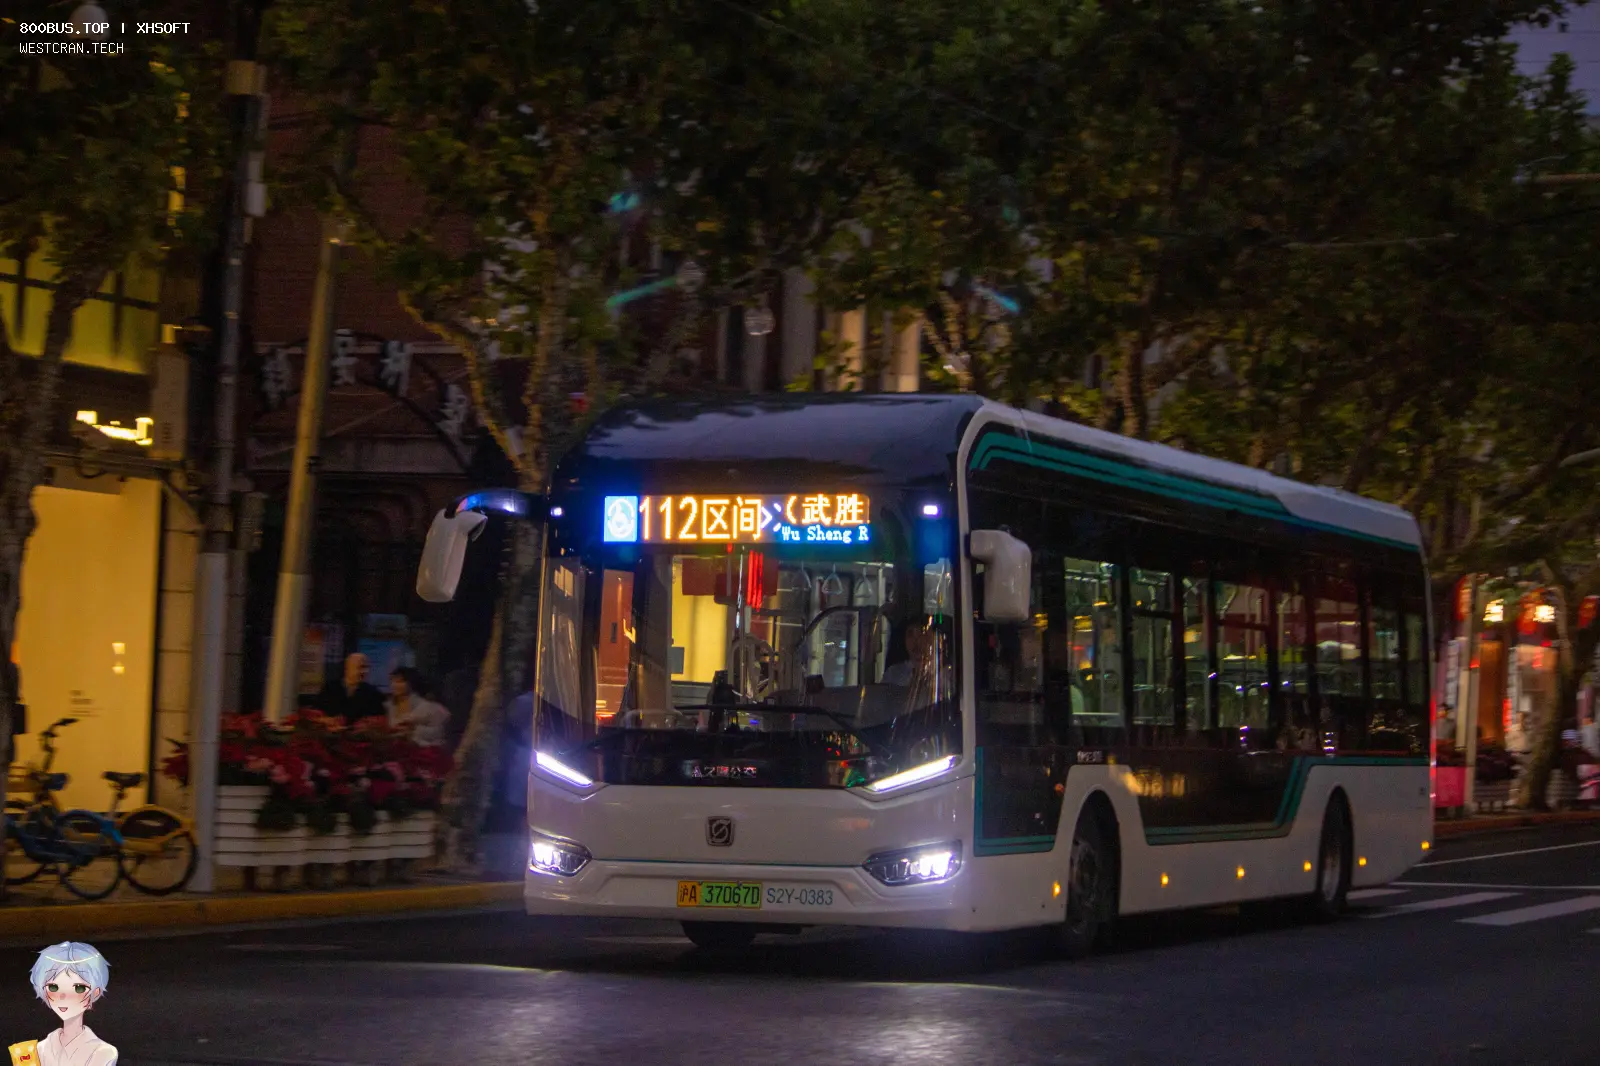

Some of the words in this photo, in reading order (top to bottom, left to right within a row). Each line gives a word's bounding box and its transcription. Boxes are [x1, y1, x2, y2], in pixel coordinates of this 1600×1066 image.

[639, 496, 762, 540] 112区间
[782, 525, 800, 541] Wu
[807, 524, 852, 543] Sheng
[858, 525, 869, 541] R
[766, 887, 834, 906] S2Y-0383
